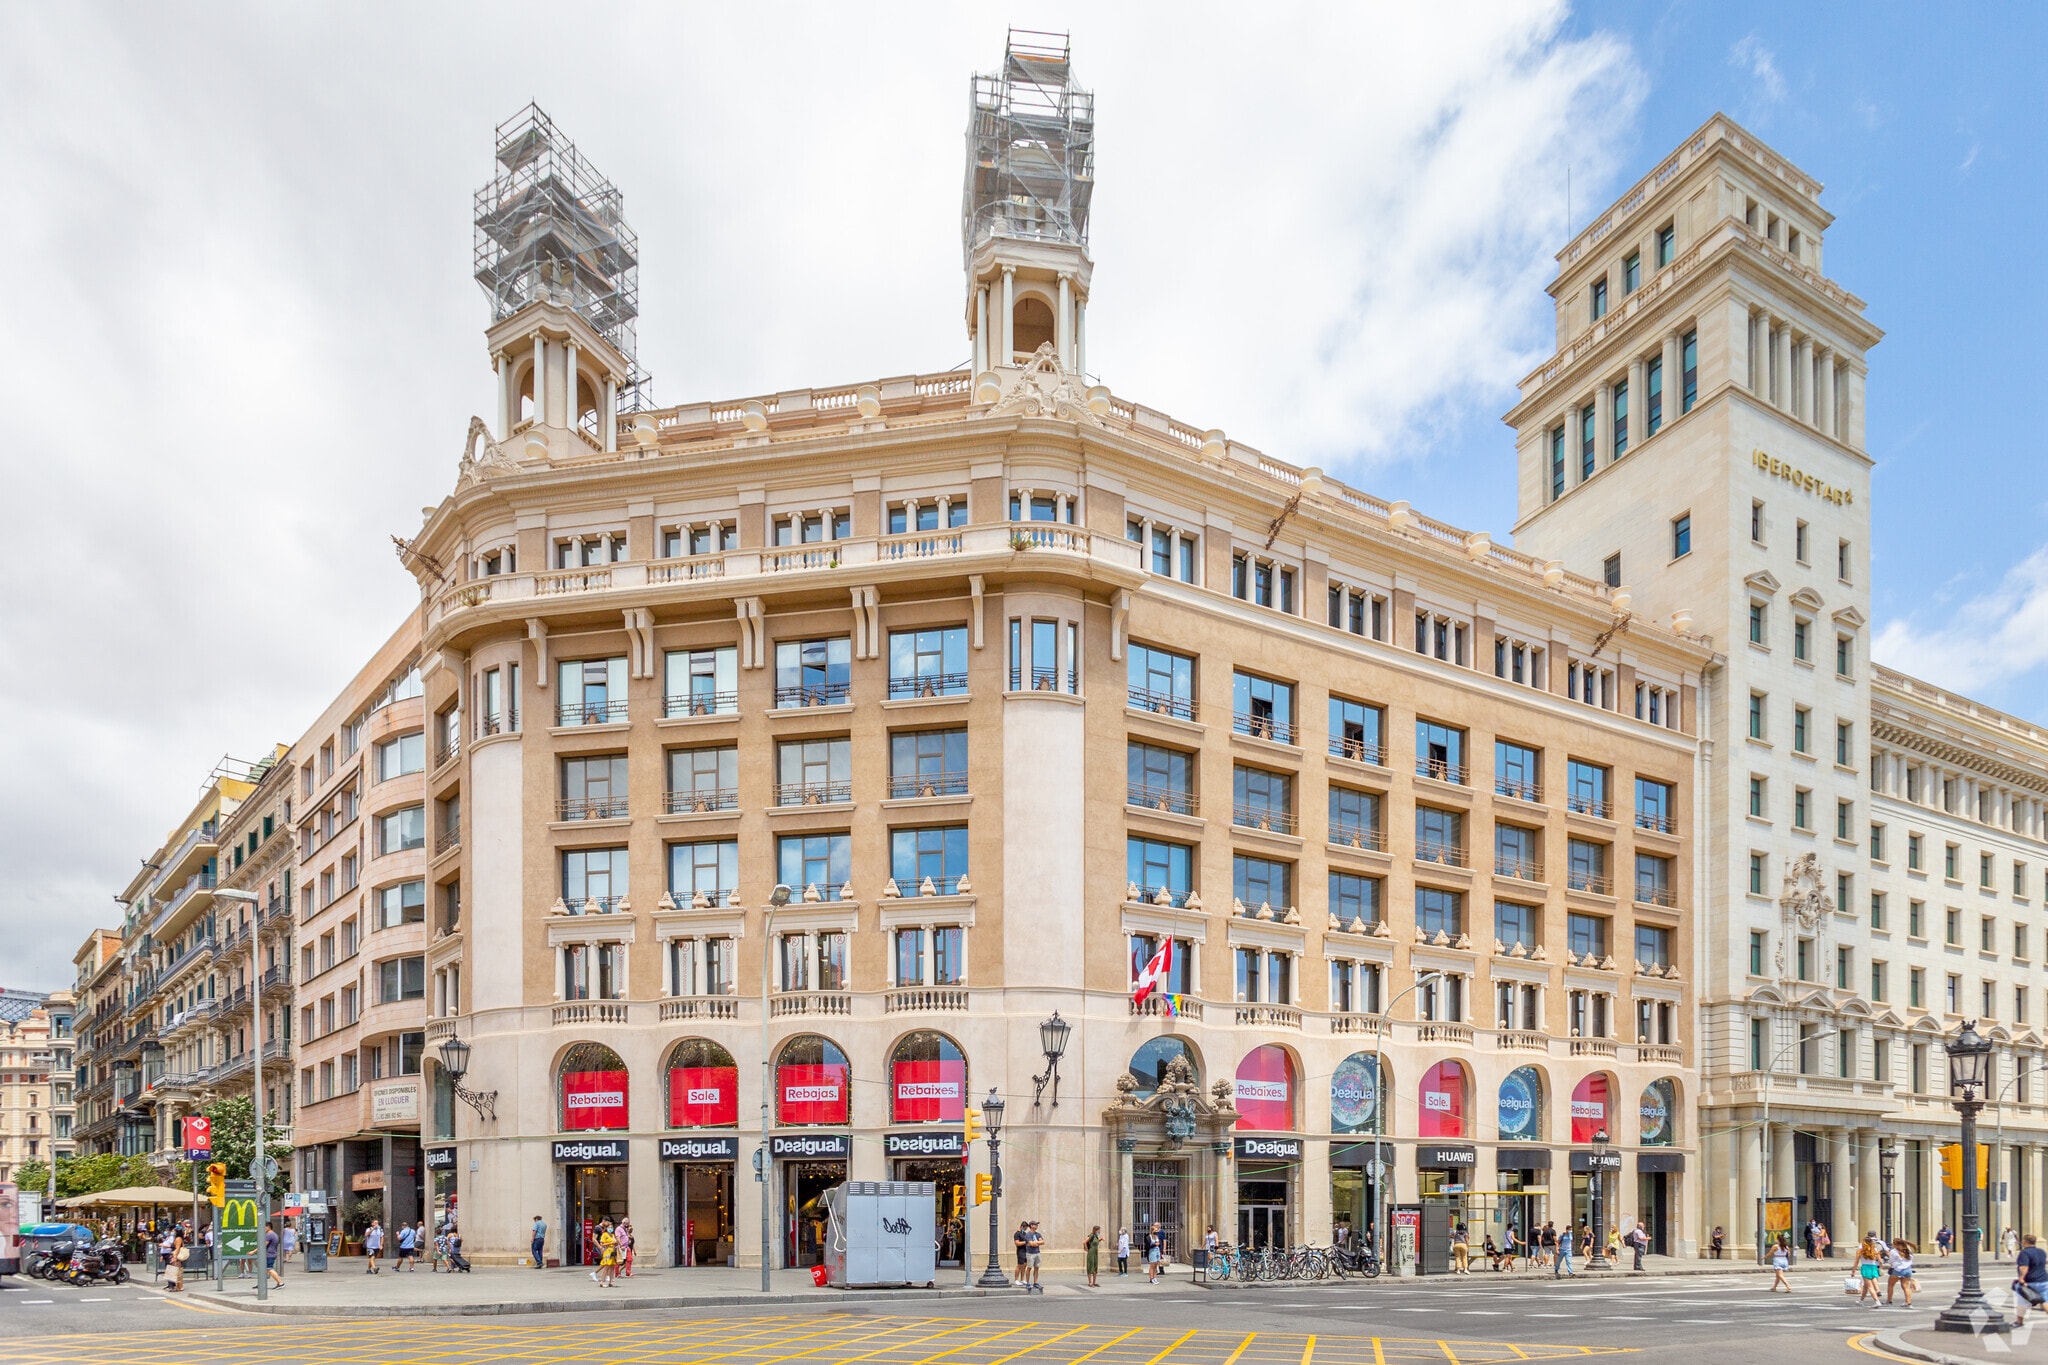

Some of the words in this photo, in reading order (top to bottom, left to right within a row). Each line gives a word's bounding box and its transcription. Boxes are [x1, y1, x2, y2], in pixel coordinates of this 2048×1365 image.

[1752, 448, 1843, 505] IBEROSTAR
[690, 1090, 717, 1101] Sale.
[788, 1088, 837, 1100] Rebajas.
[901, 1085, 957, 1096] Rebaixes.
[1238, 1084, 1285, 1098] Rebaixes.
[385, 1096, 409, 1105] LLOGUER
[570, 1095, 622, 1105] Rebaixes.
[1428, 1096, 1448, 1107] Sale.
[1437, 1152, 1474, 1162] HUAWEI
